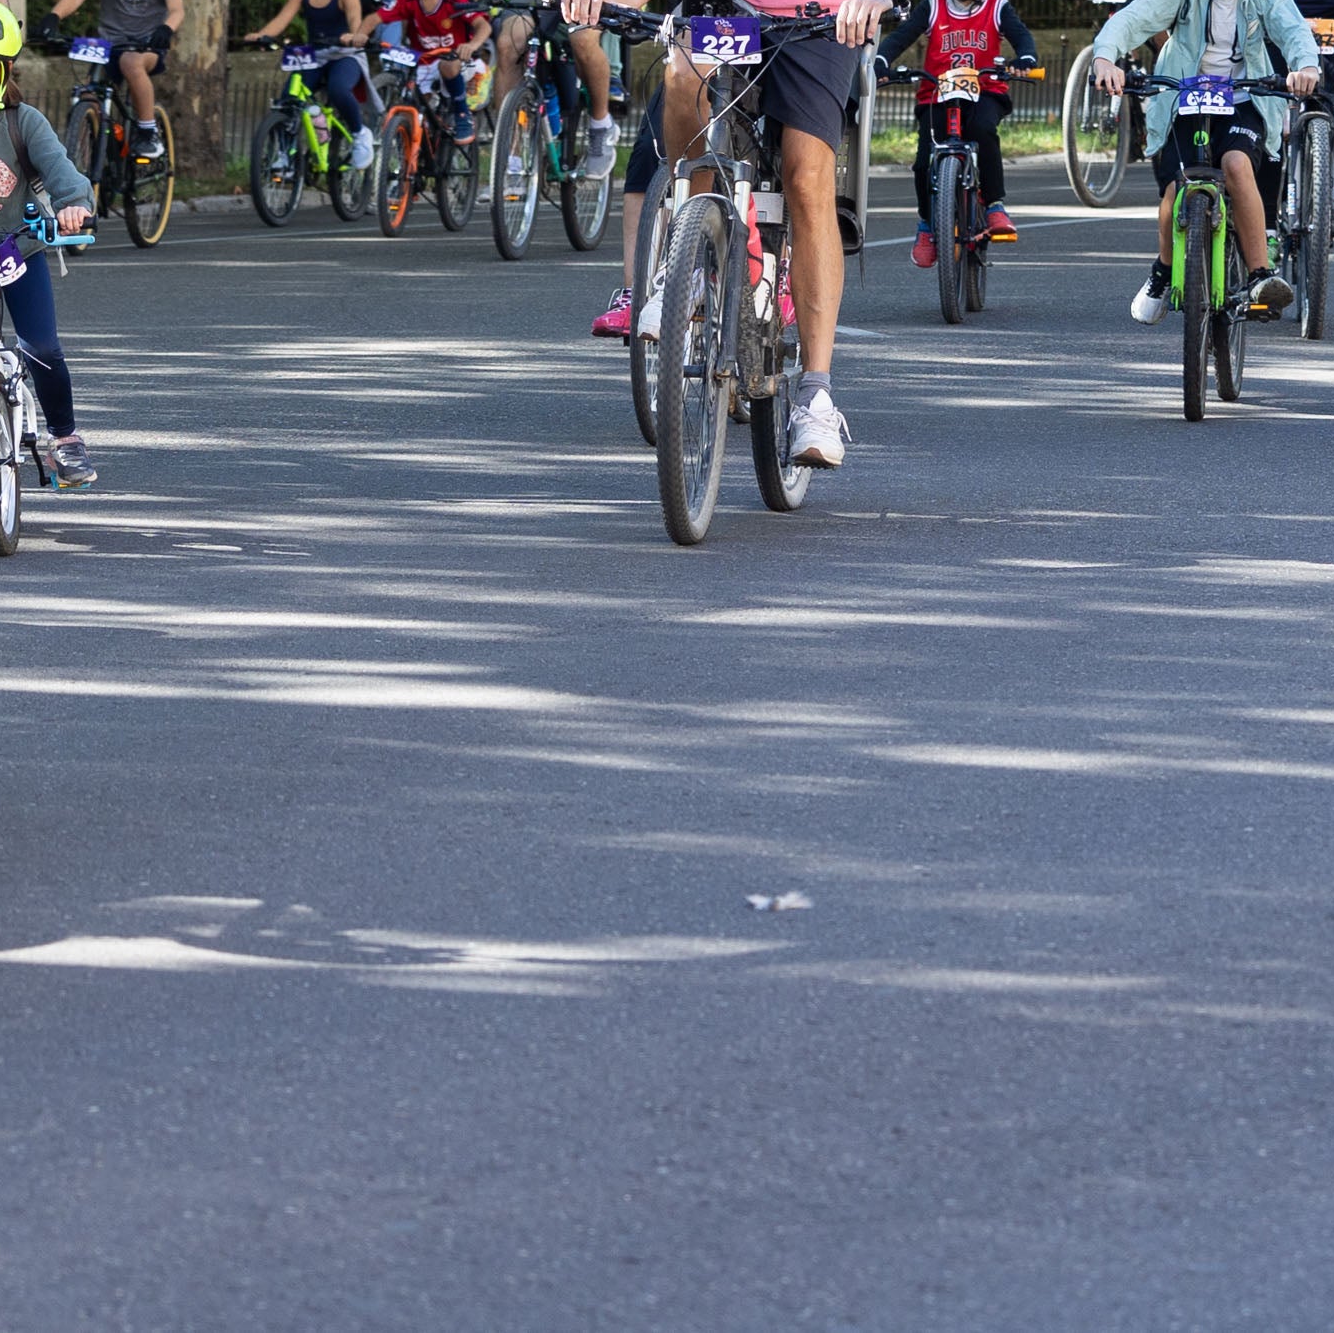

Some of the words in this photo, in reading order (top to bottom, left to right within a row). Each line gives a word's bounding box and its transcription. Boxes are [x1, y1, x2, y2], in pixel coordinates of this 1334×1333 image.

[702, 34, 750, 54] 227
[940, 28, 988, 53] BULLS
[950, 52, 975, 70] 23
[1186, 90, 1226, 106] 644
